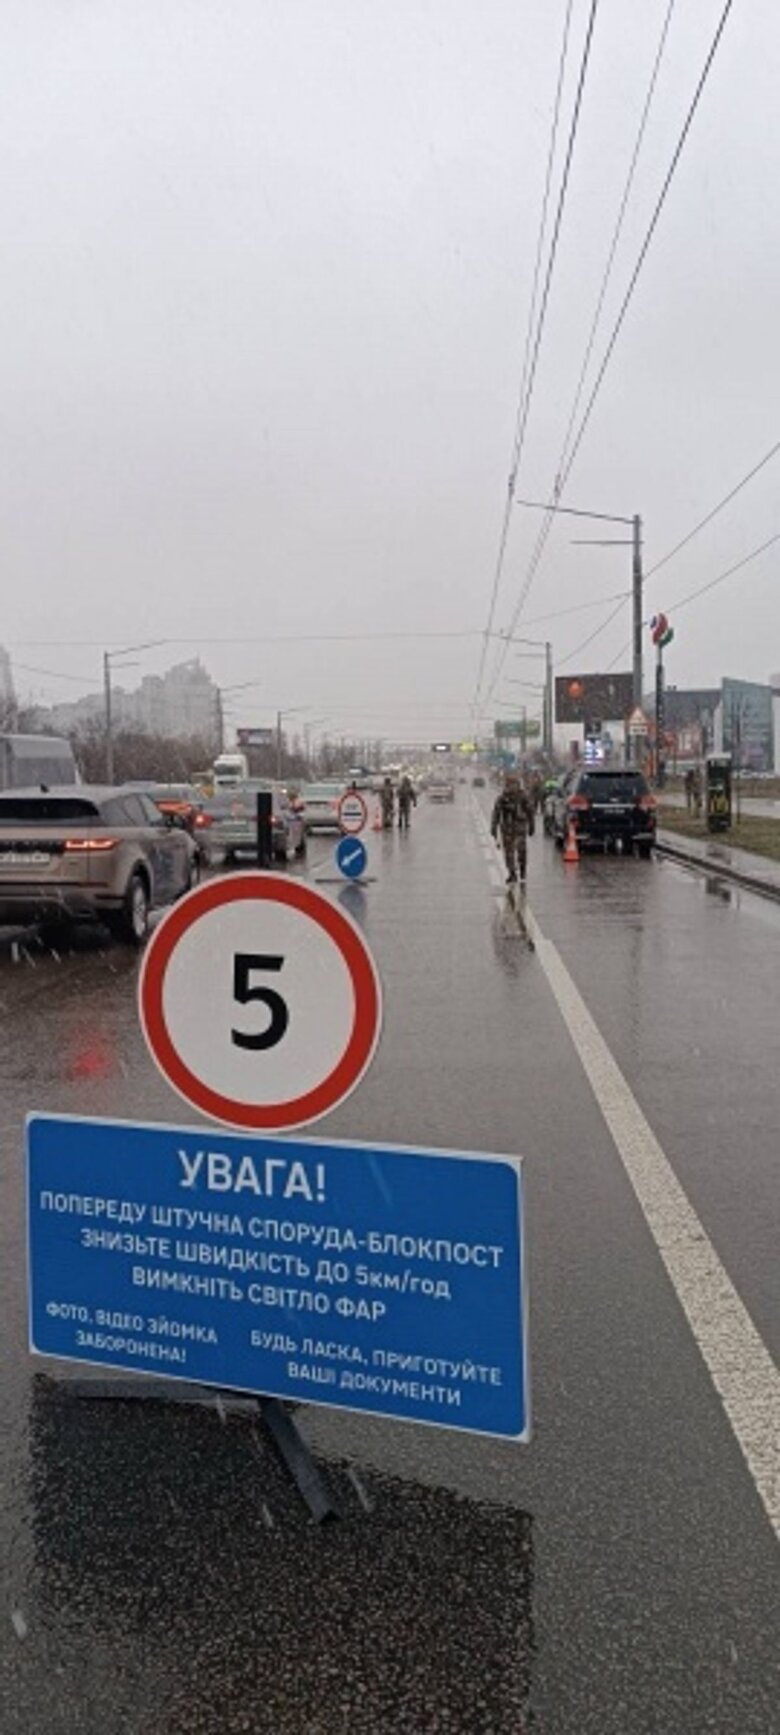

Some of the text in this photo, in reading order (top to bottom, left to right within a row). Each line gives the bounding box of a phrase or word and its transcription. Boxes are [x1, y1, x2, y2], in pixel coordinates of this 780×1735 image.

[231, 953, 290, 1051] 5
[178, 1150, 325, 1202] УВАГА!
[41, 1192, 504, 1268] ПОПЕРЕДУ ШТУЧНА СПОРУДА-БЛОКПОСТ
[80, 1229, 451, 1299] ЗНИЗЬТЕ ШВИДКІСТЬ ДО 5км/год
[133, 1267, 386, 1322] ВИМКНІТЬ СВІТЛО ФАР
[76, 1331, 186, 1363] ЗАБОРОНЕНА!
[96, 1310, 143, 1332] ВІДЕО
[148, 1316, 218, 1344] ЗЙОМКА
[251, 1331, 502, 1386] БУДЬ ЛАСКА, ПРИГОТУЙТЕ
[287, 1362, 461, 1406] ВАШІ ДОКУМЕНТИ
